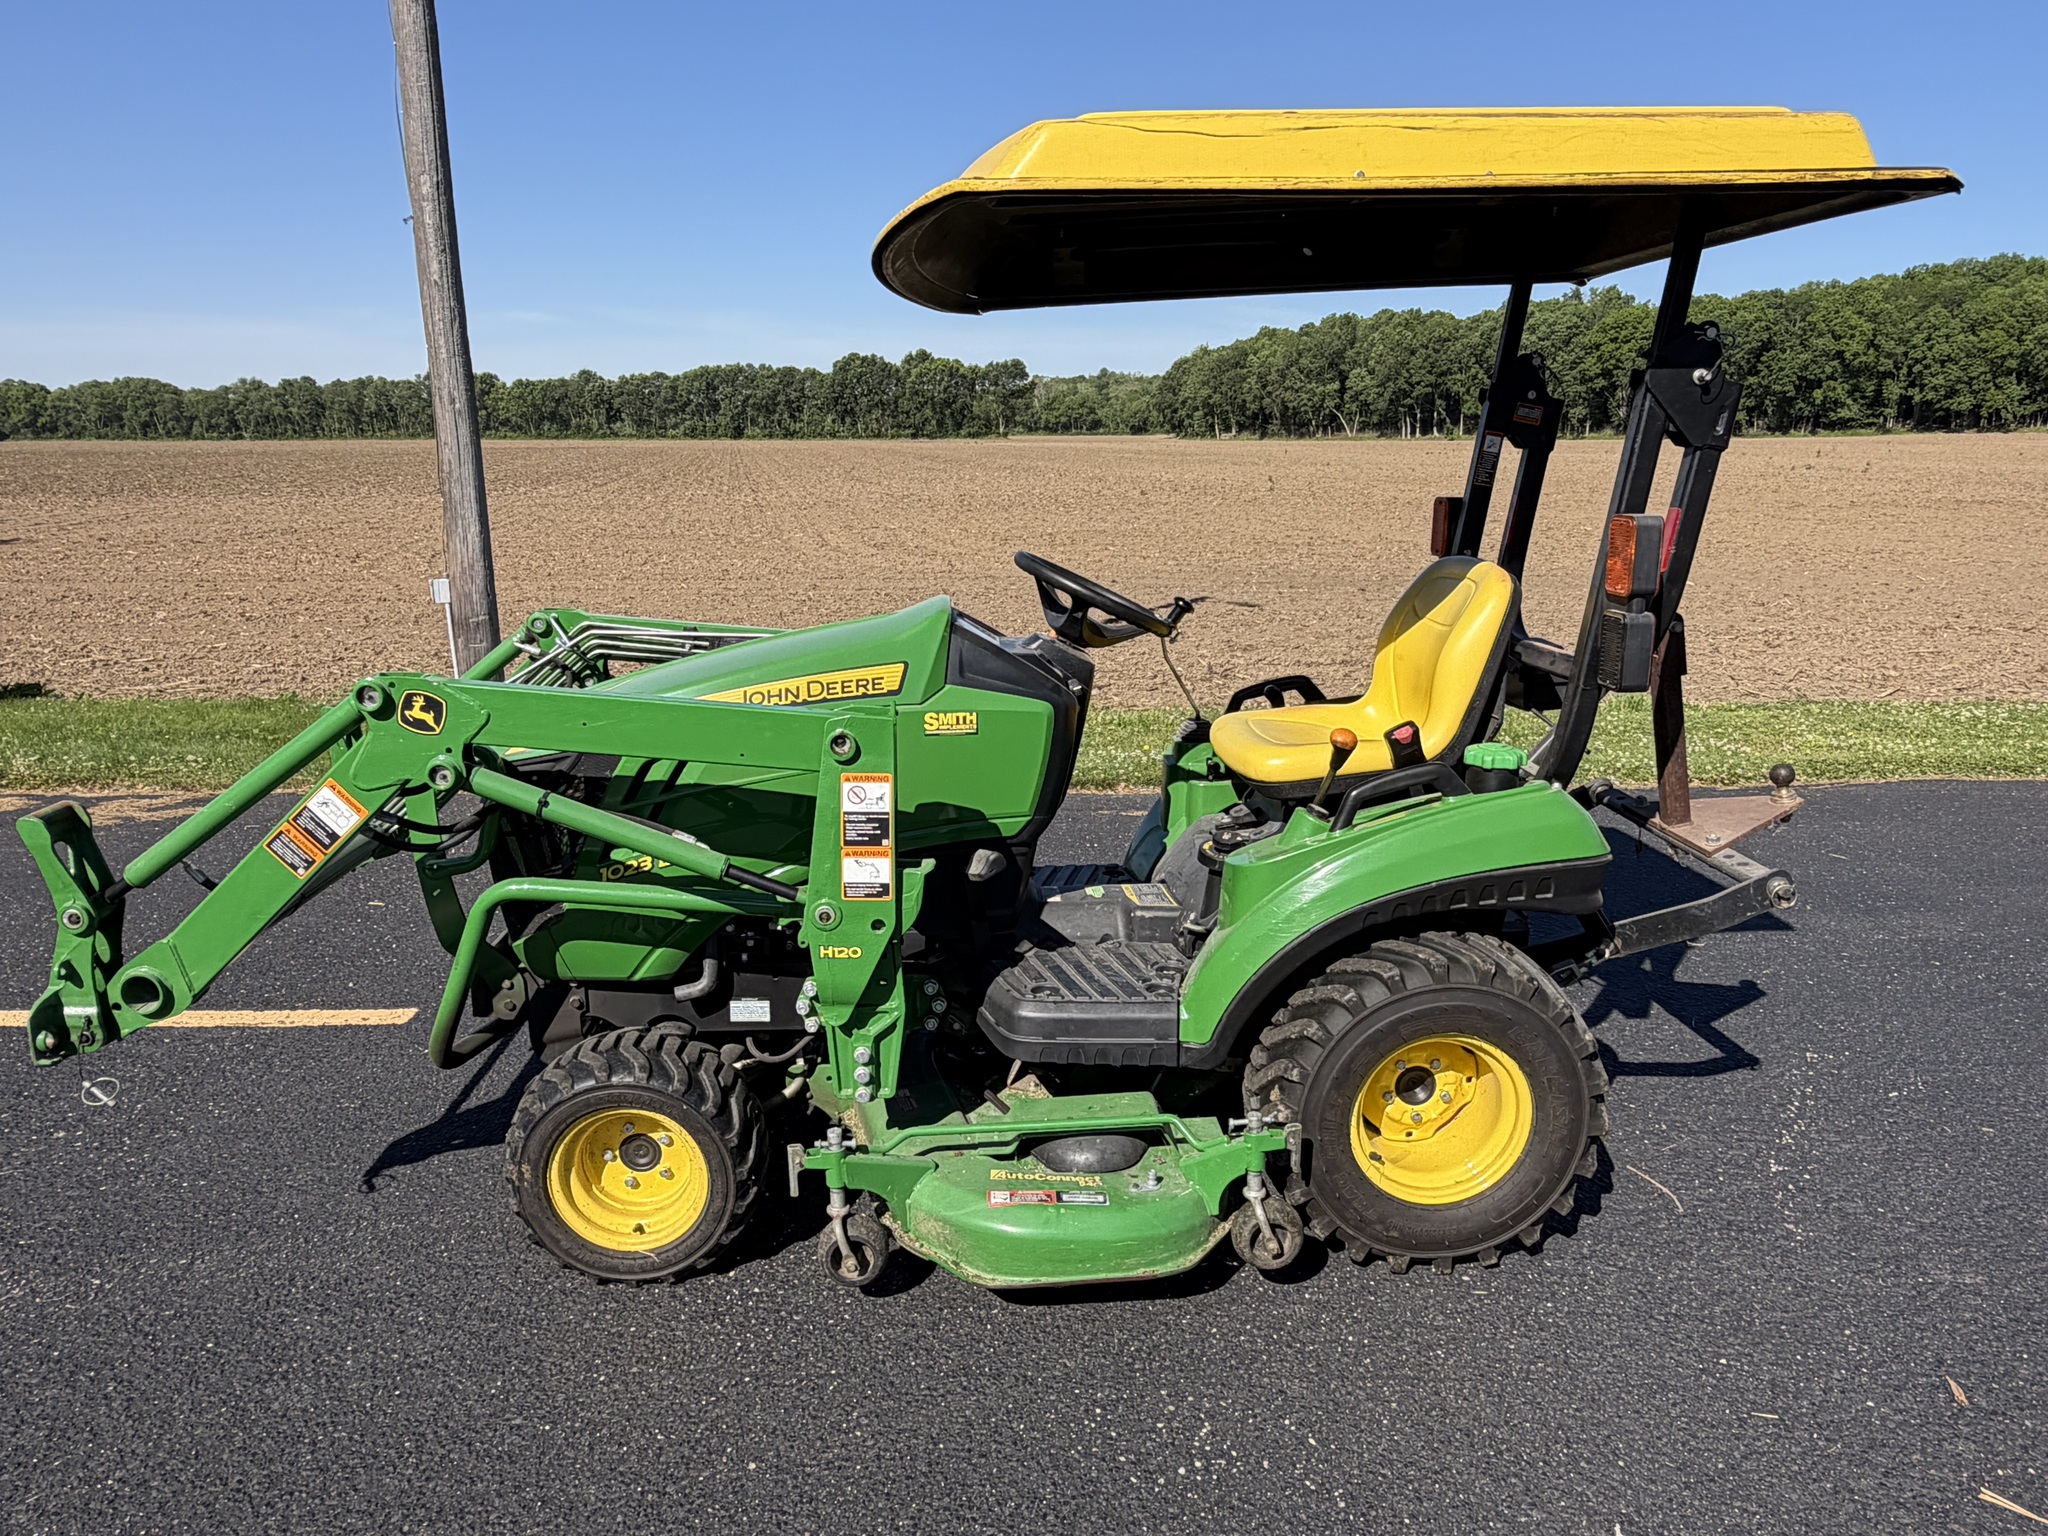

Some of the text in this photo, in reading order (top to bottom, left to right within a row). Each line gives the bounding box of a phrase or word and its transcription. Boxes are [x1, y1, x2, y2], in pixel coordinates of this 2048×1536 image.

[743, 677, 884, 704] JOHN DEERE
[924, 712, 977, 731] SMITH
[851, 775, 889, 783] WARNING
[336, 789, 362, 813] WARNING
[292, 834, 318, 857] WARNING
[819, 945, 862, 958] H120
[990, 1169, 1101, 1182] AutoConnect
